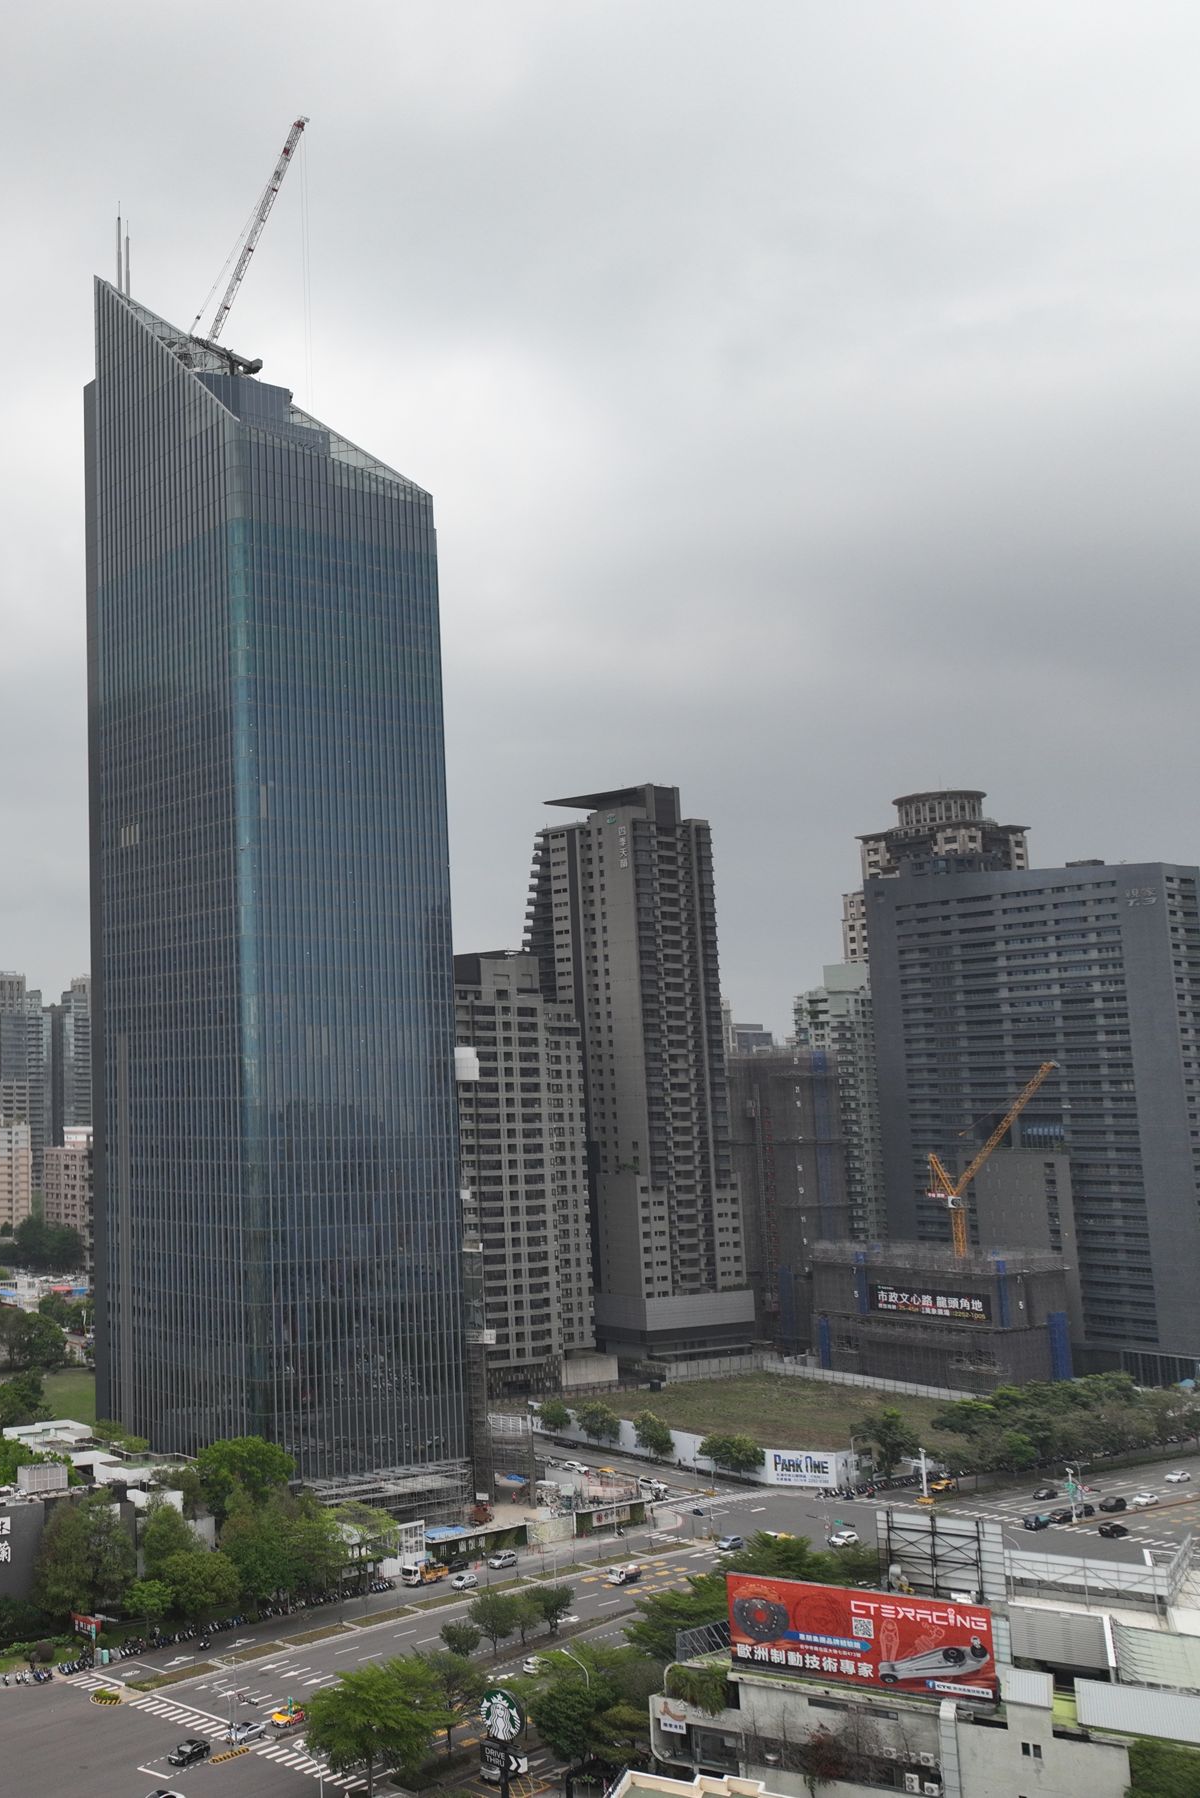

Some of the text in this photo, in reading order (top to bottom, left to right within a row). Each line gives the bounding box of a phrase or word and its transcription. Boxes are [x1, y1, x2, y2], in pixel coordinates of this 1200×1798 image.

[878, 1291, 933, 1307] 市政文心路
[936, 1296, 984, 1312] 龍頭角地
[774, 1454, 830, 1475] PARK ONE
[737, 1643, 874, 1679] 歐洲制動技術專家
[484, 1747, 506, 1761] DRIVE
[485, 1754, 505, 1767] THRU
